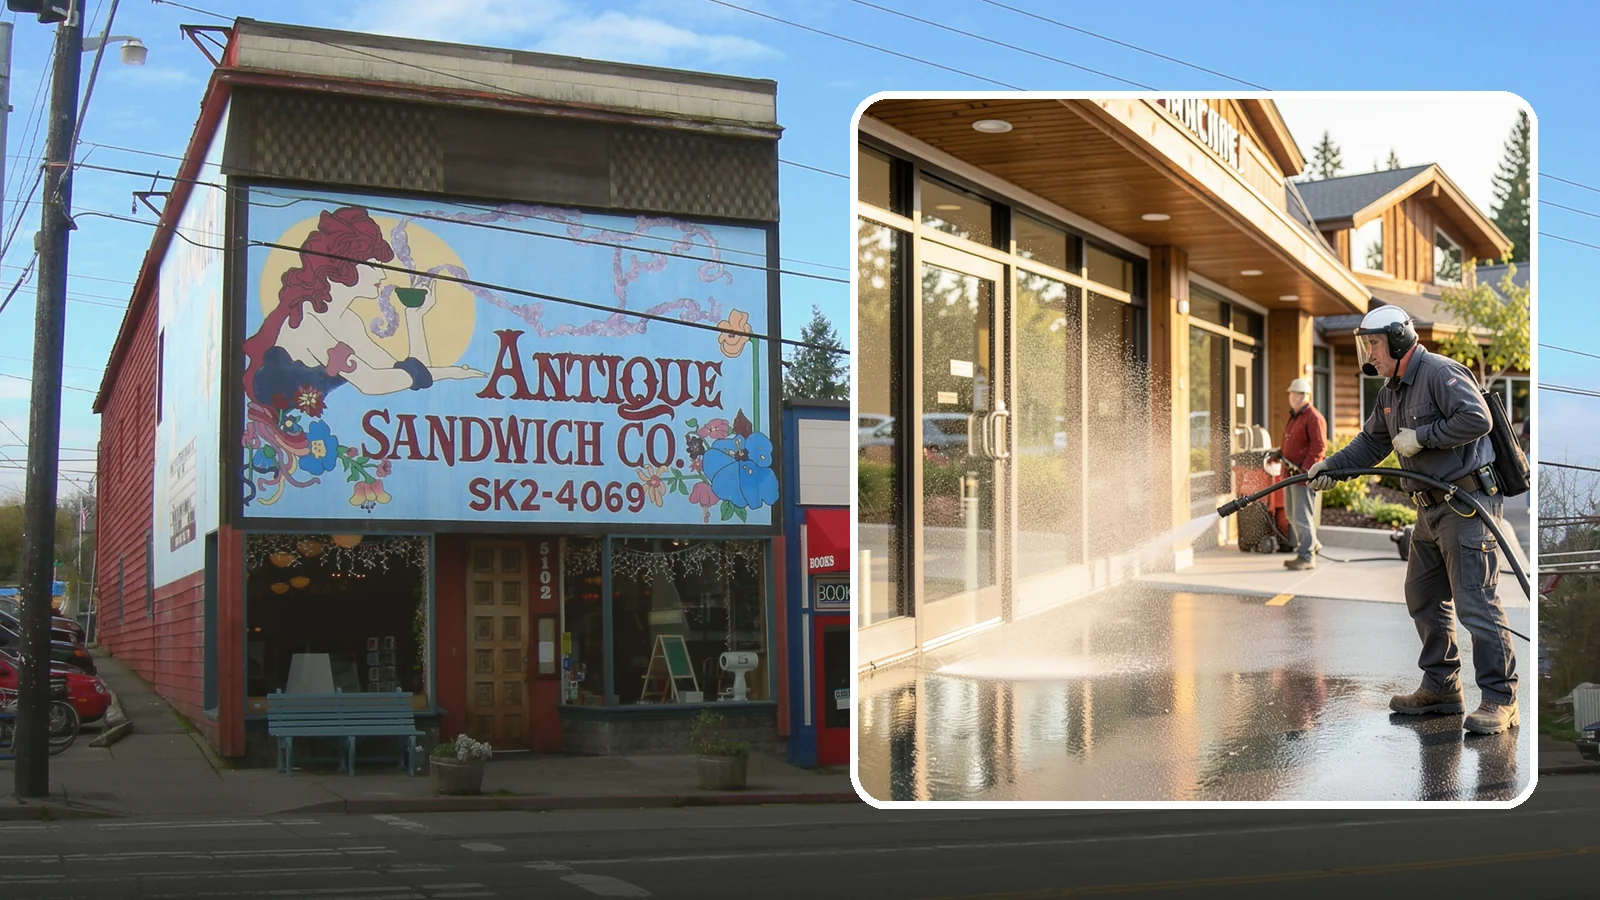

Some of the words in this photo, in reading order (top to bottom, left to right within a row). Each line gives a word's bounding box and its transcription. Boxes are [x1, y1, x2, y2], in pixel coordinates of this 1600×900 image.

[476, 329, 723, 421] ANTIQUE
[361, 409, 604, 467] SANDWICH
[617, 422, 685, 468] CO.
[469, 477, 645, 513] SK2-4069
[540, 542, 551, 599] 5102
[809, 555, 834, 569] BOOKS
